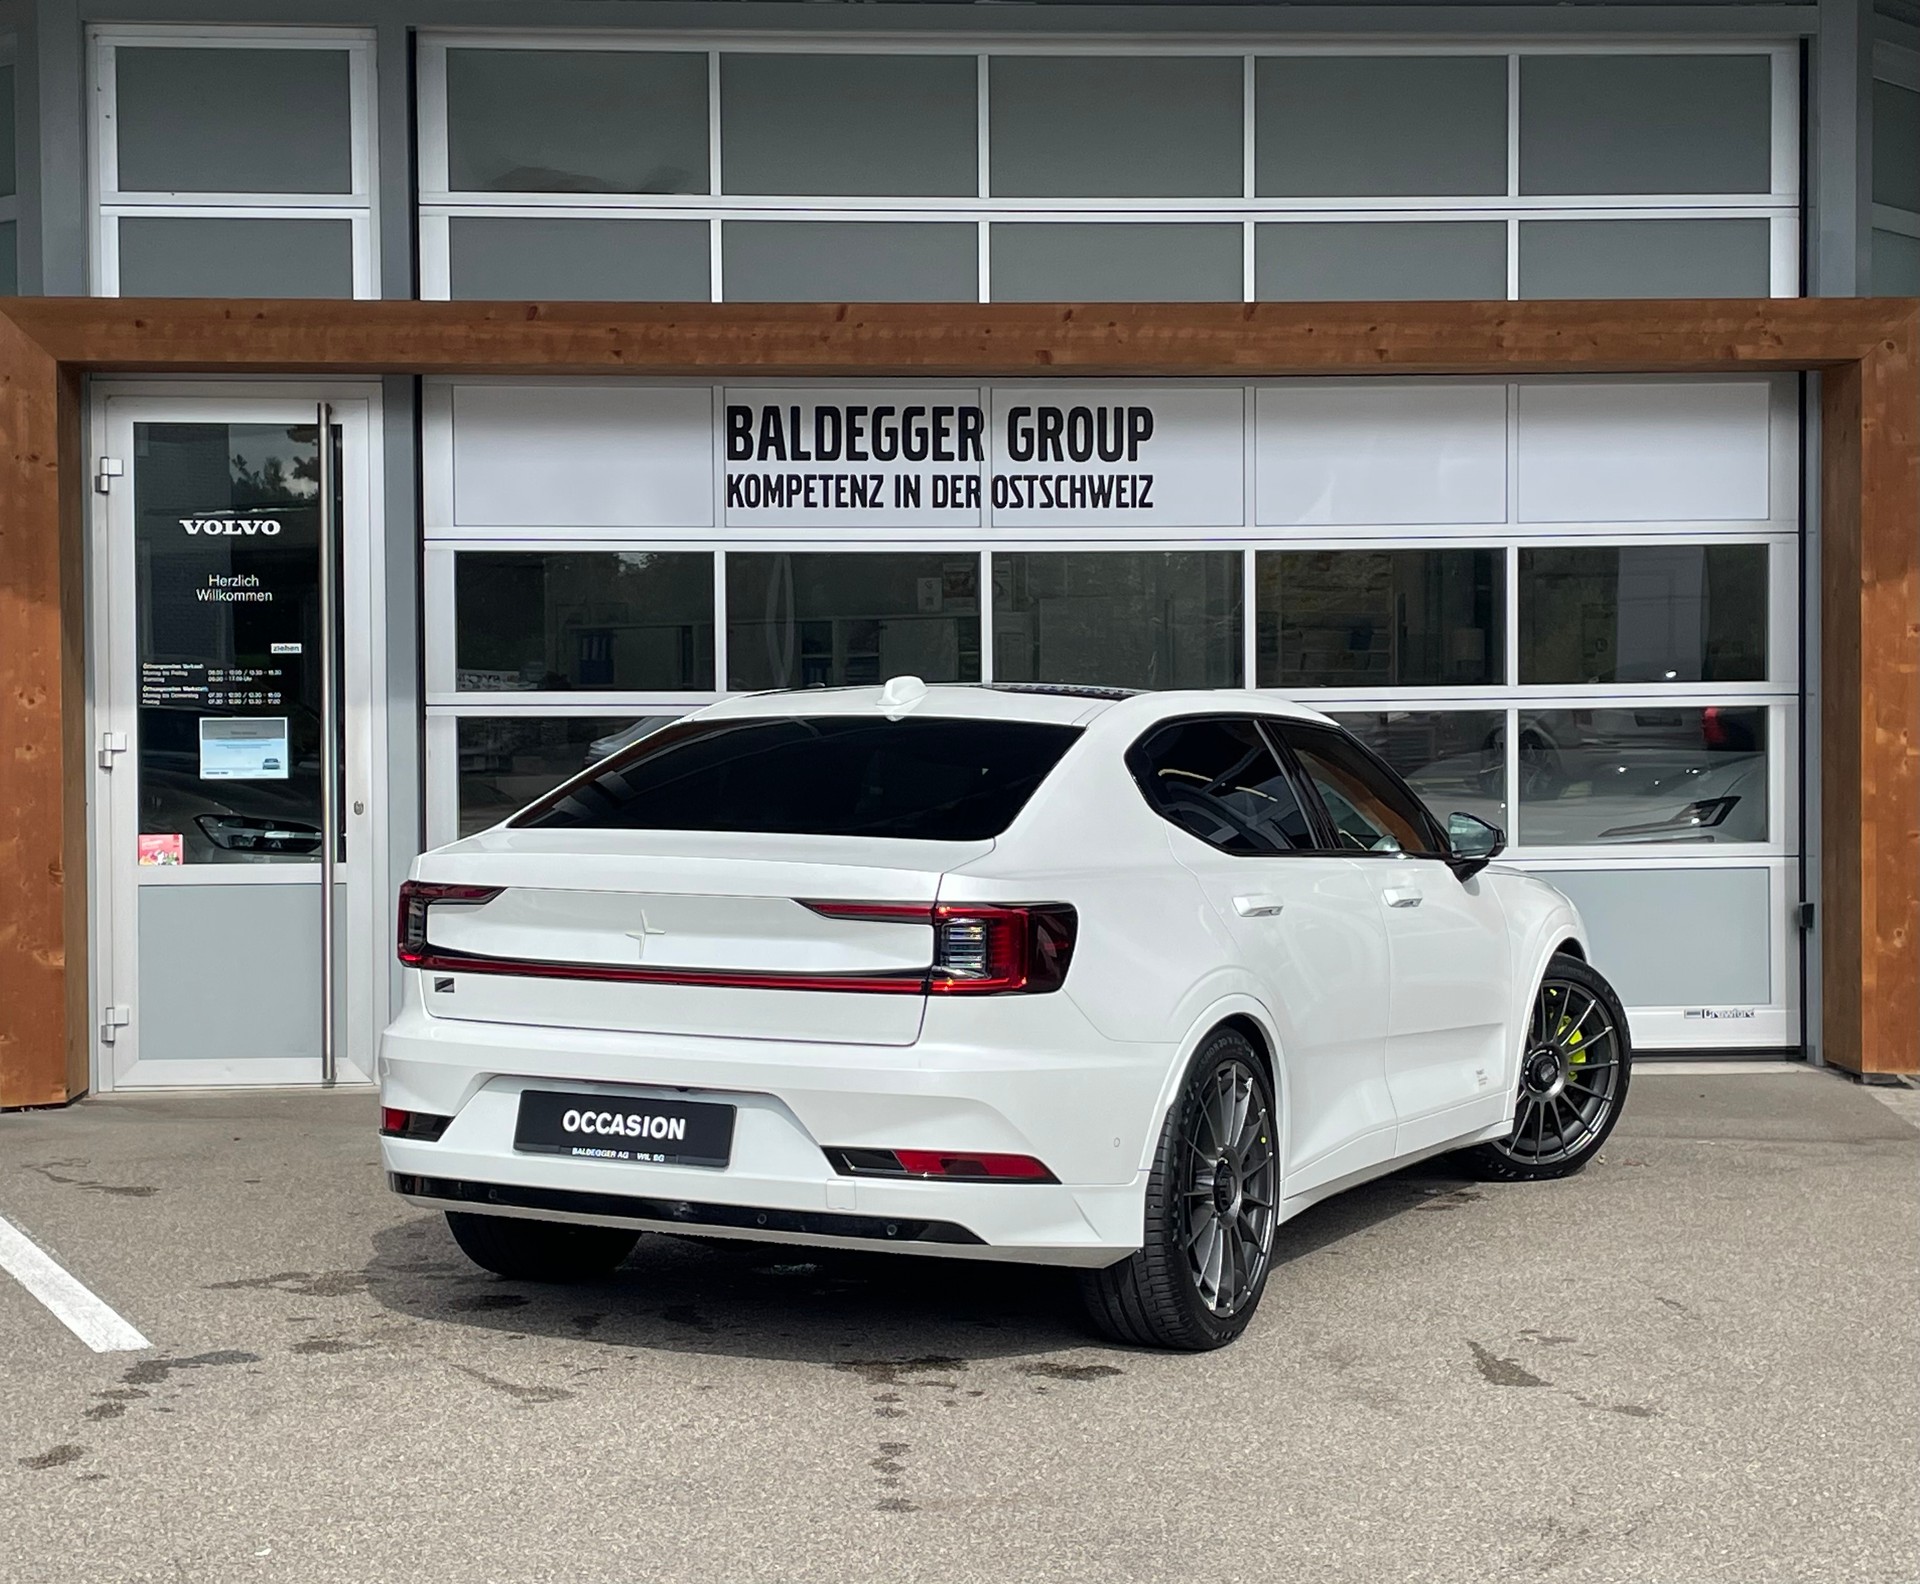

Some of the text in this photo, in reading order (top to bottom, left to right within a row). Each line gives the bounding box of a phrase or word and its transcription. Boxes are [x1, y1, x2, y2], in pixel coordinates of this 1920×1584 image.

[726, 405, 1154, 463] BALDEGGER GROUP
[726, 474, 1154, 509] KOMPETENZ IN DER OSTSCHWEIZ
[178, 519, 281, 536] VOLVO
[208, 574, 259, 587] Herzlich
[195, 588, 273, 601] Willkommen
[272, 644, 300, 652] ziehen
[561, 1109, 686, 1140] OCCASION
[572, 1147, 616, 1158] BALDEGGER
[617, 1150, 629, 1159] AG
[637, 1152, 651, 1161] WIL
